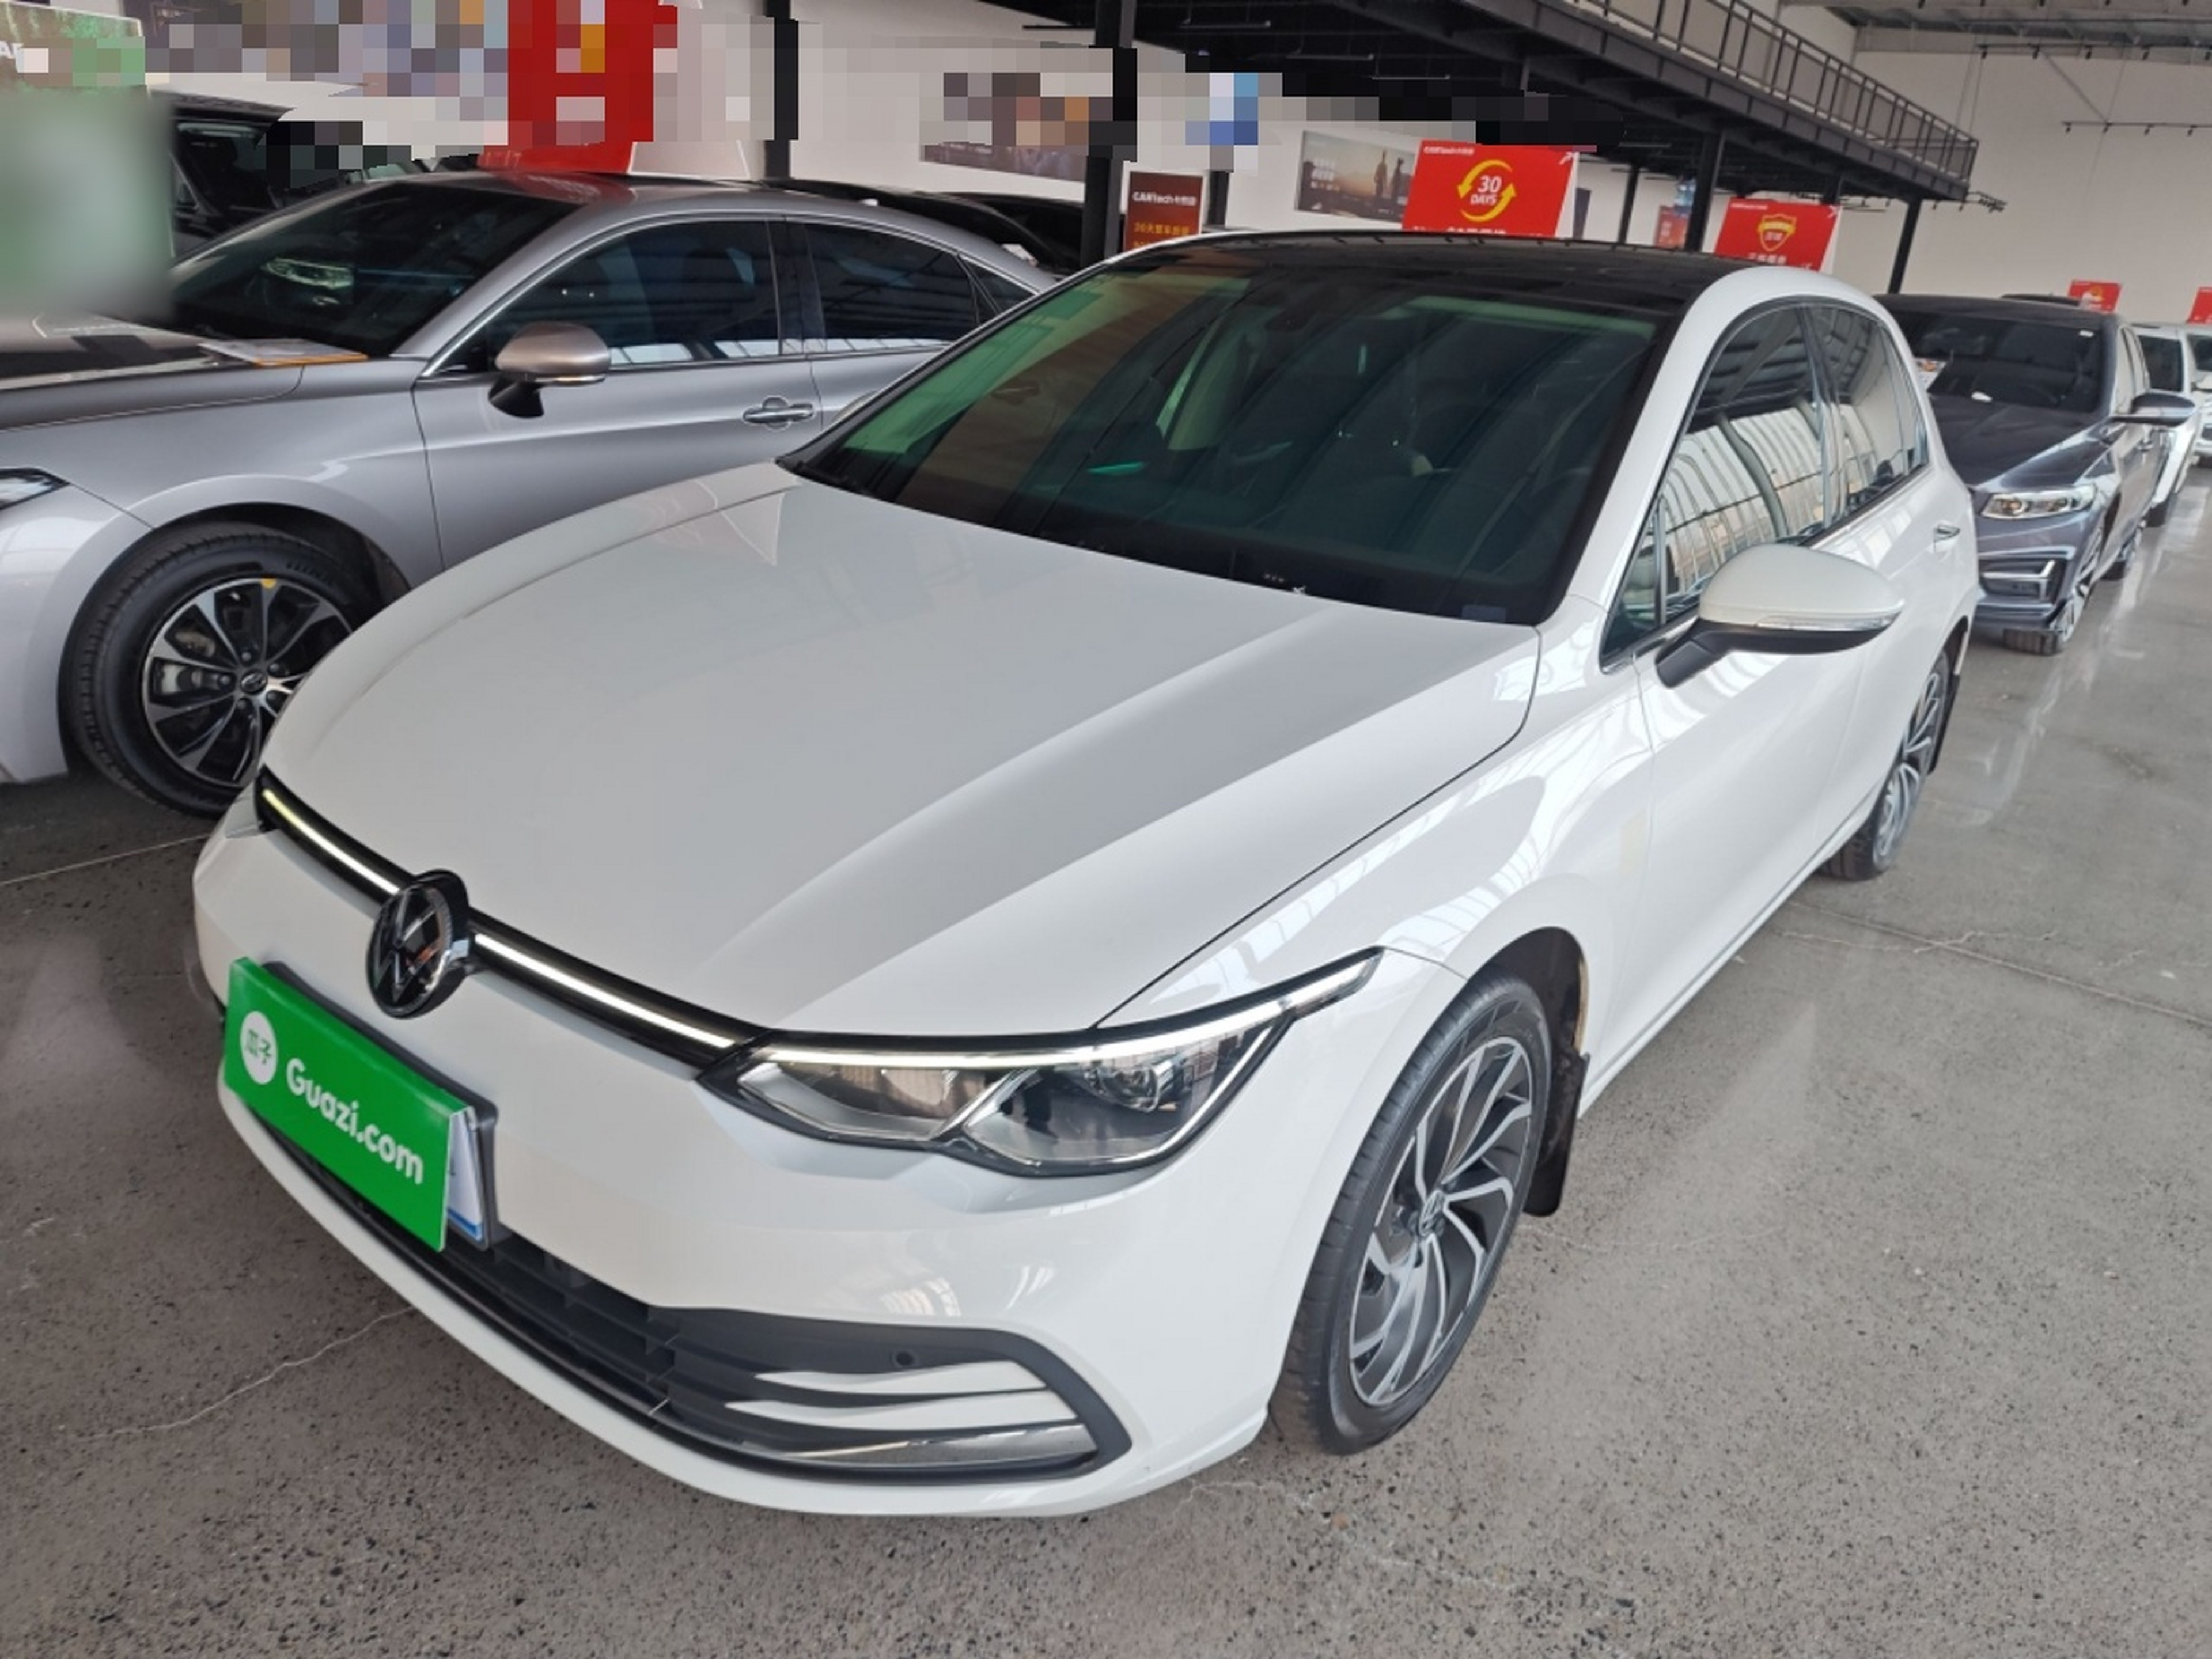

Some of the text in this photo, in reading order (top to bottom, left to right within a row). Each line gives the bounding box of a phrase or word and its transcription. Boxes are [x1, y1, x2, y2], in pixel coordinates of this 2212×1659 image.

[1477, 175, 1502, 193] 30
[1470, 194, 1498, 206] DAYS
[286, 1058, 424, 1185] Guazi.com
